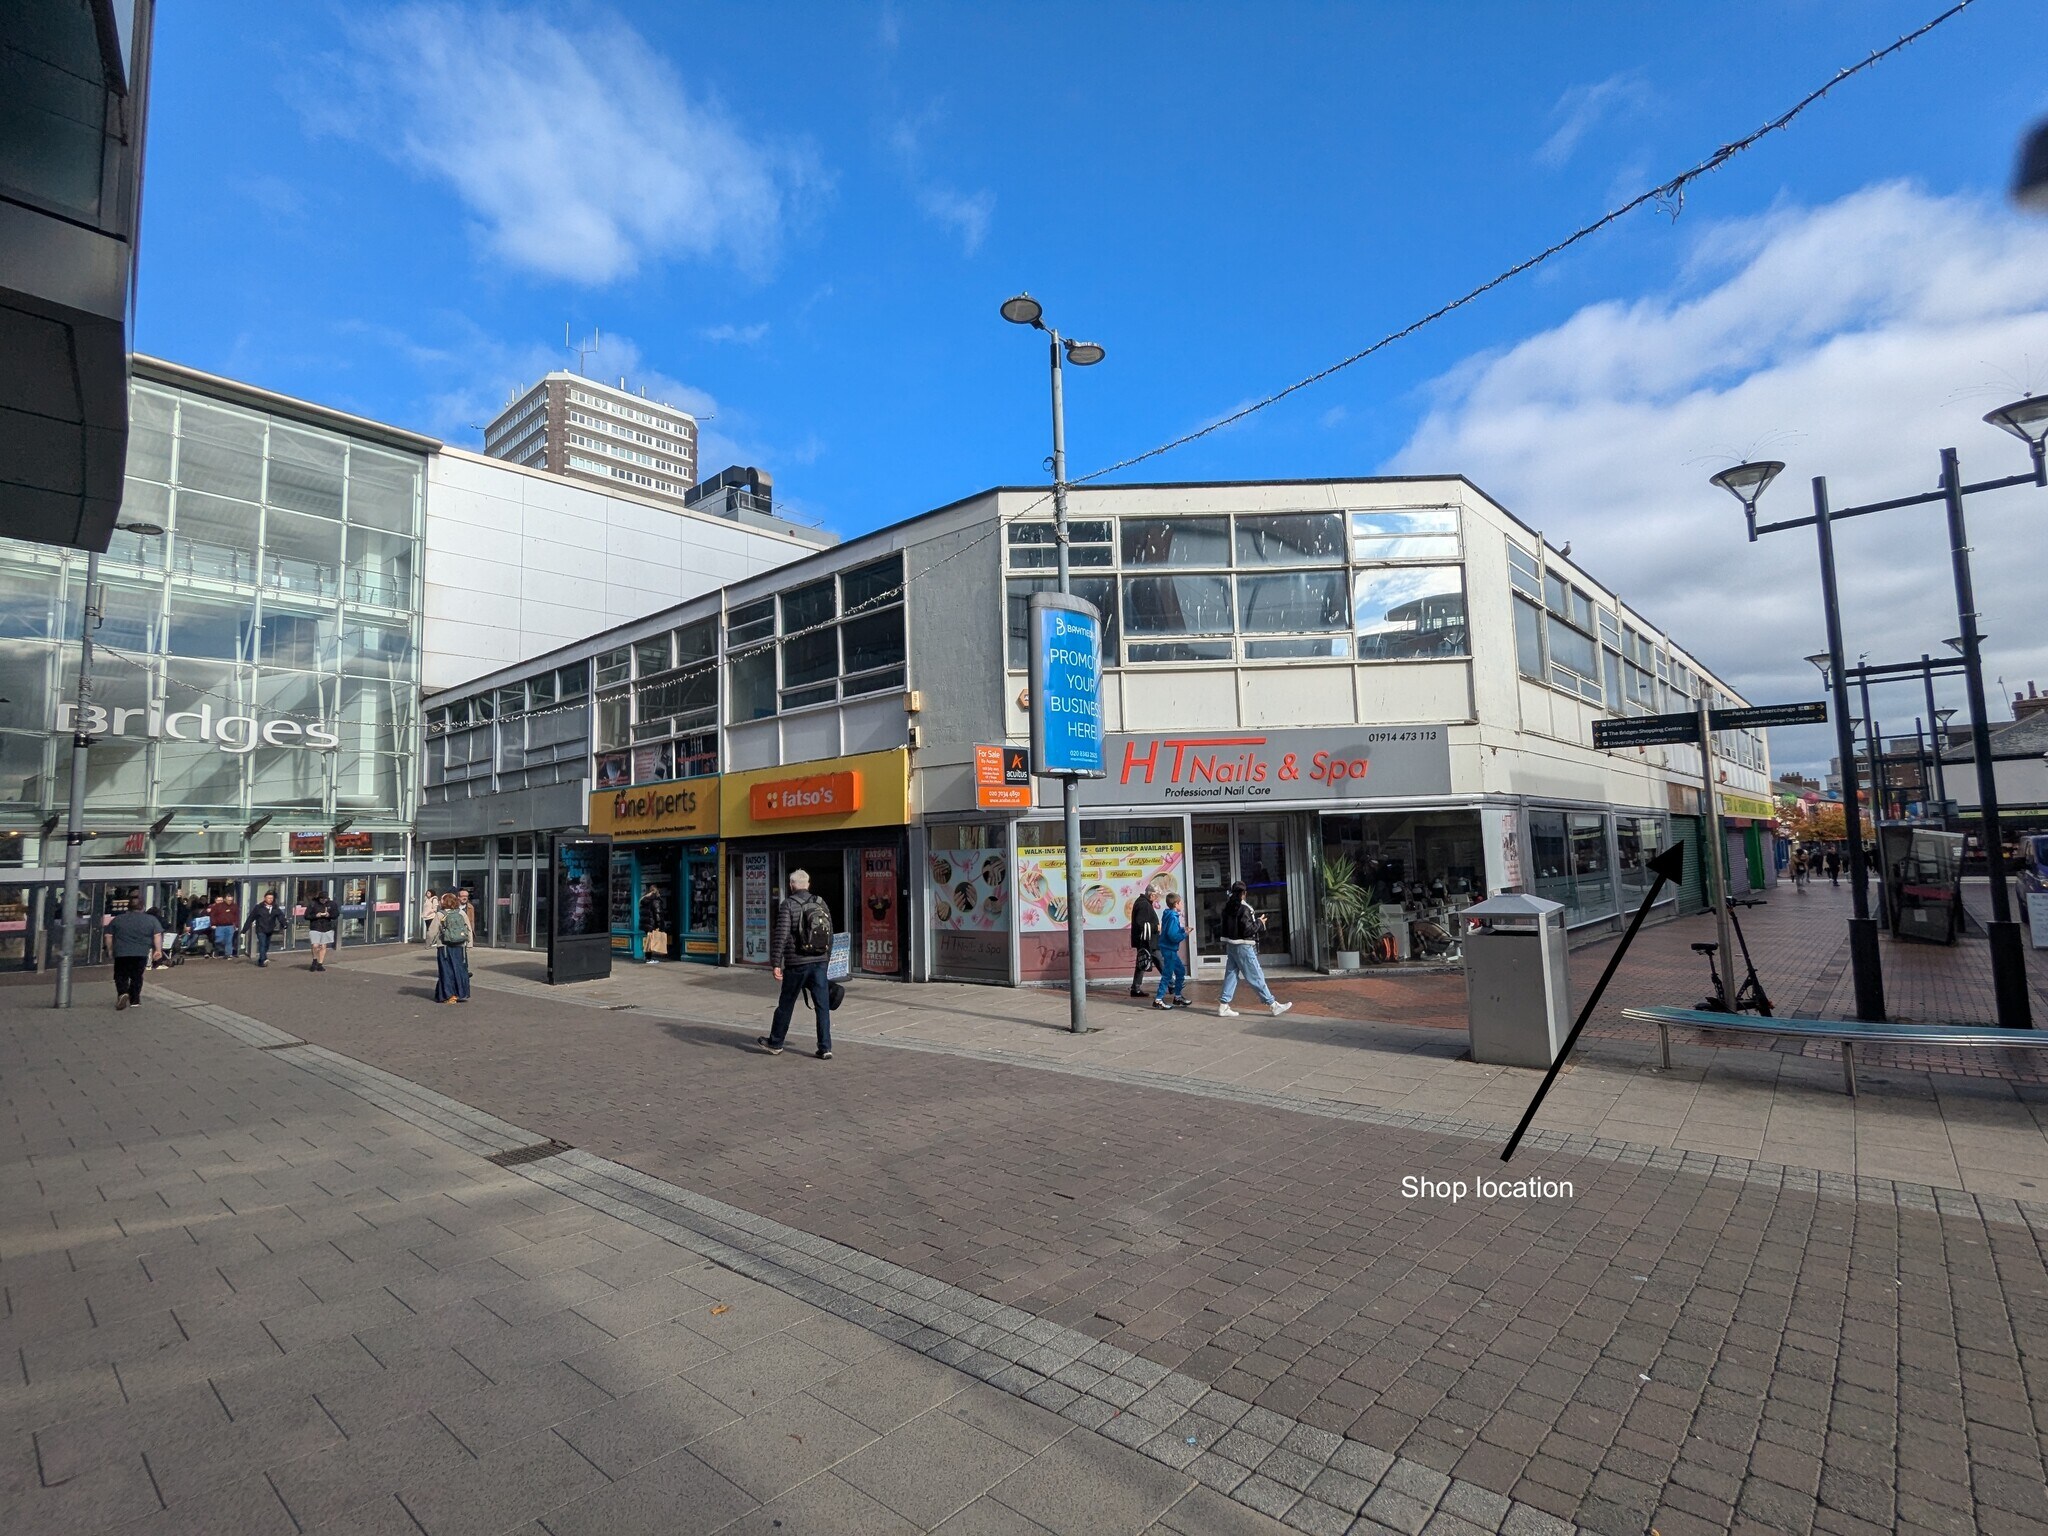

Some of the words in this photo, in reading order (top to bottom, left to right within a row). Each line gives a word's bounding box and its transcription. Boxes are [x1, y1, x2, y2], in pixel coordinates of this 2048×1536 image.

[1050, 648, 1098, 671] PROMOT
[1066, 673, 1095, 693] YOUR
[1761, 706, 1796, 714] Interchange
[55, 702, 339, 752] Bridges
[1638, 727, 1665, 735] Shopping
[1368, 732, 1397, 743] 01914
[1399, 731, 1417, 742] 473
[1420, 730, 1437, 741] 113
[1608, 739, 1635, 747] University
[1188, 752, 1269, 784] Nails
[1277, 753, 1299, 781] &
[1309, 751, 1369, 787] Spa
[781, 787, 834, 808] fatso's
[1164, 786, 1222, 797] Professional
[1224, 785, 1245, 796] Nail
[1247, 785, 1271, 795] Care
[866, 860, 892, 871] HOT
[745, 870, 767, 880] SOUPS
[866, 940, 893, 953] BIG
